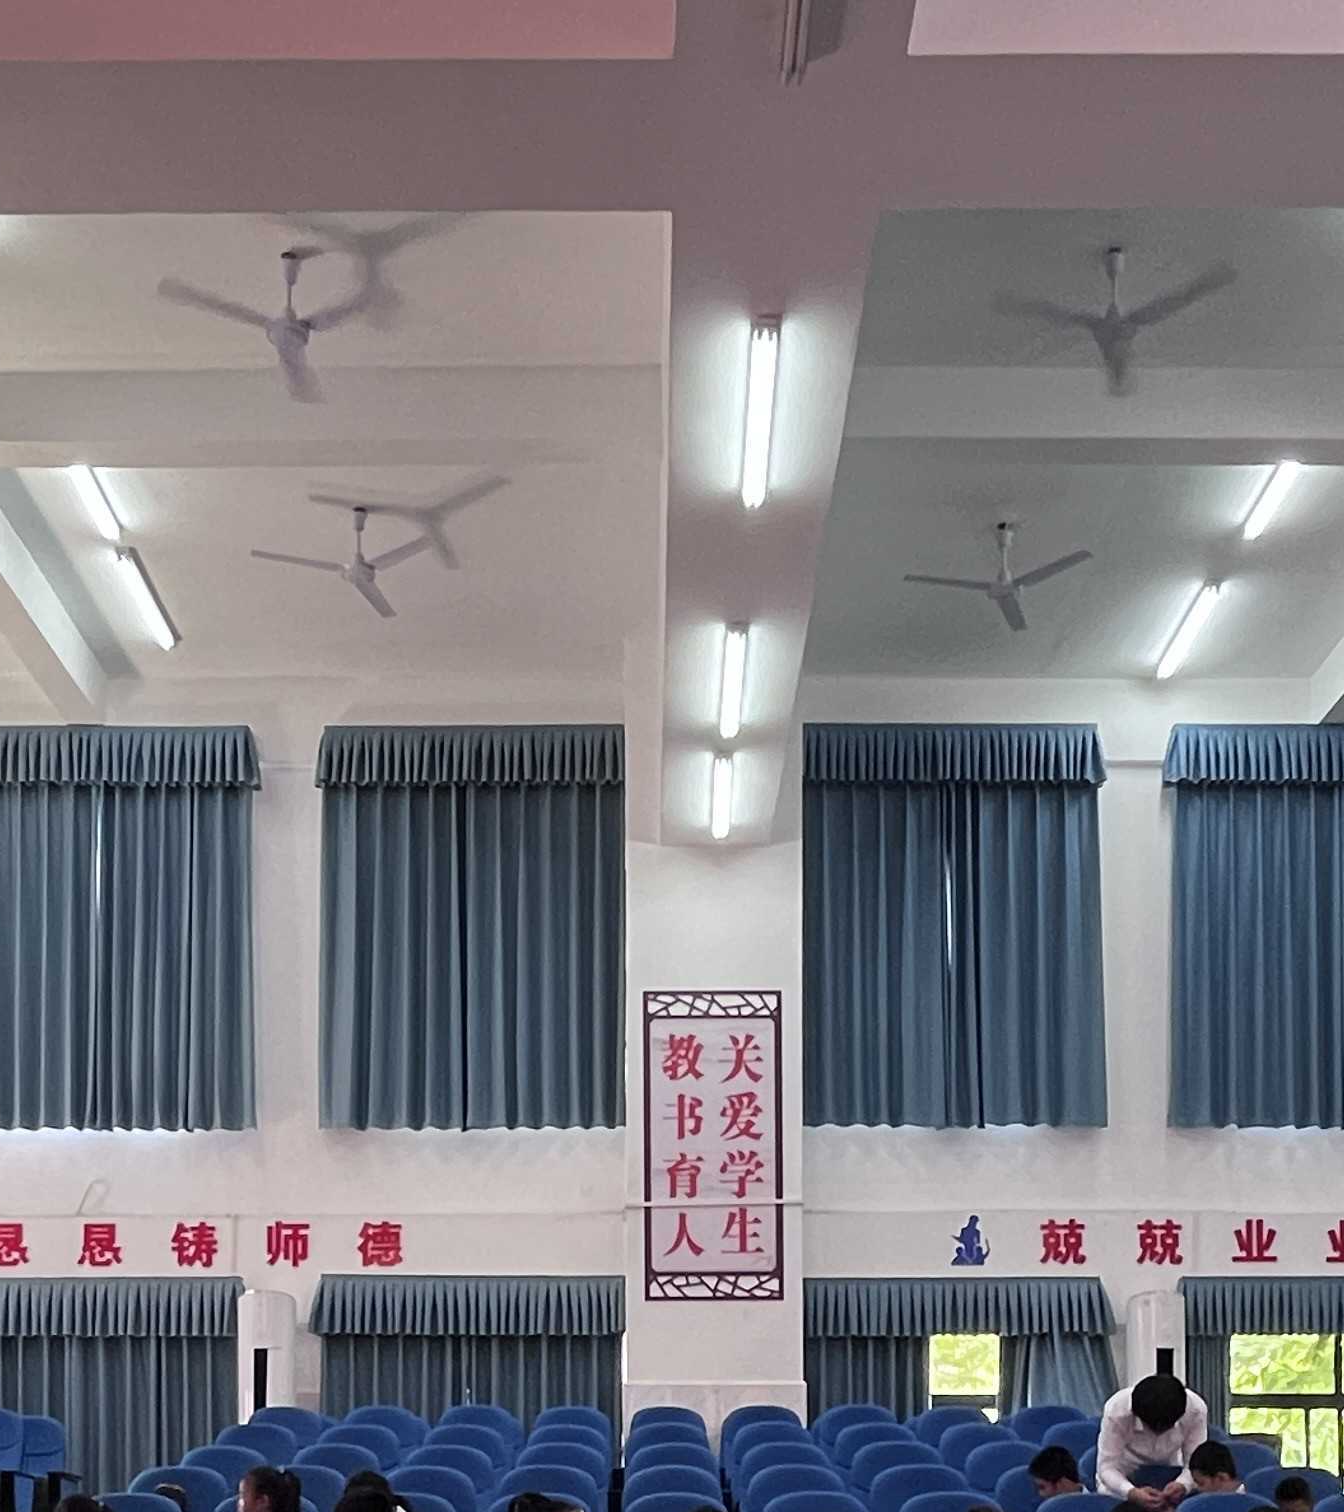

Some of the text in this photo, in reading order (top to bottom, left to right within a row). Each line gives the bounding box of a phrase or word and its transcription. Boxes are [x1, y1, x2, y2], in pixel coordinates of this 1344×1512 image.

[662, 1034, 704, 1256] 教书育人
[718, 1034, 765, 1256] 关爱学生
